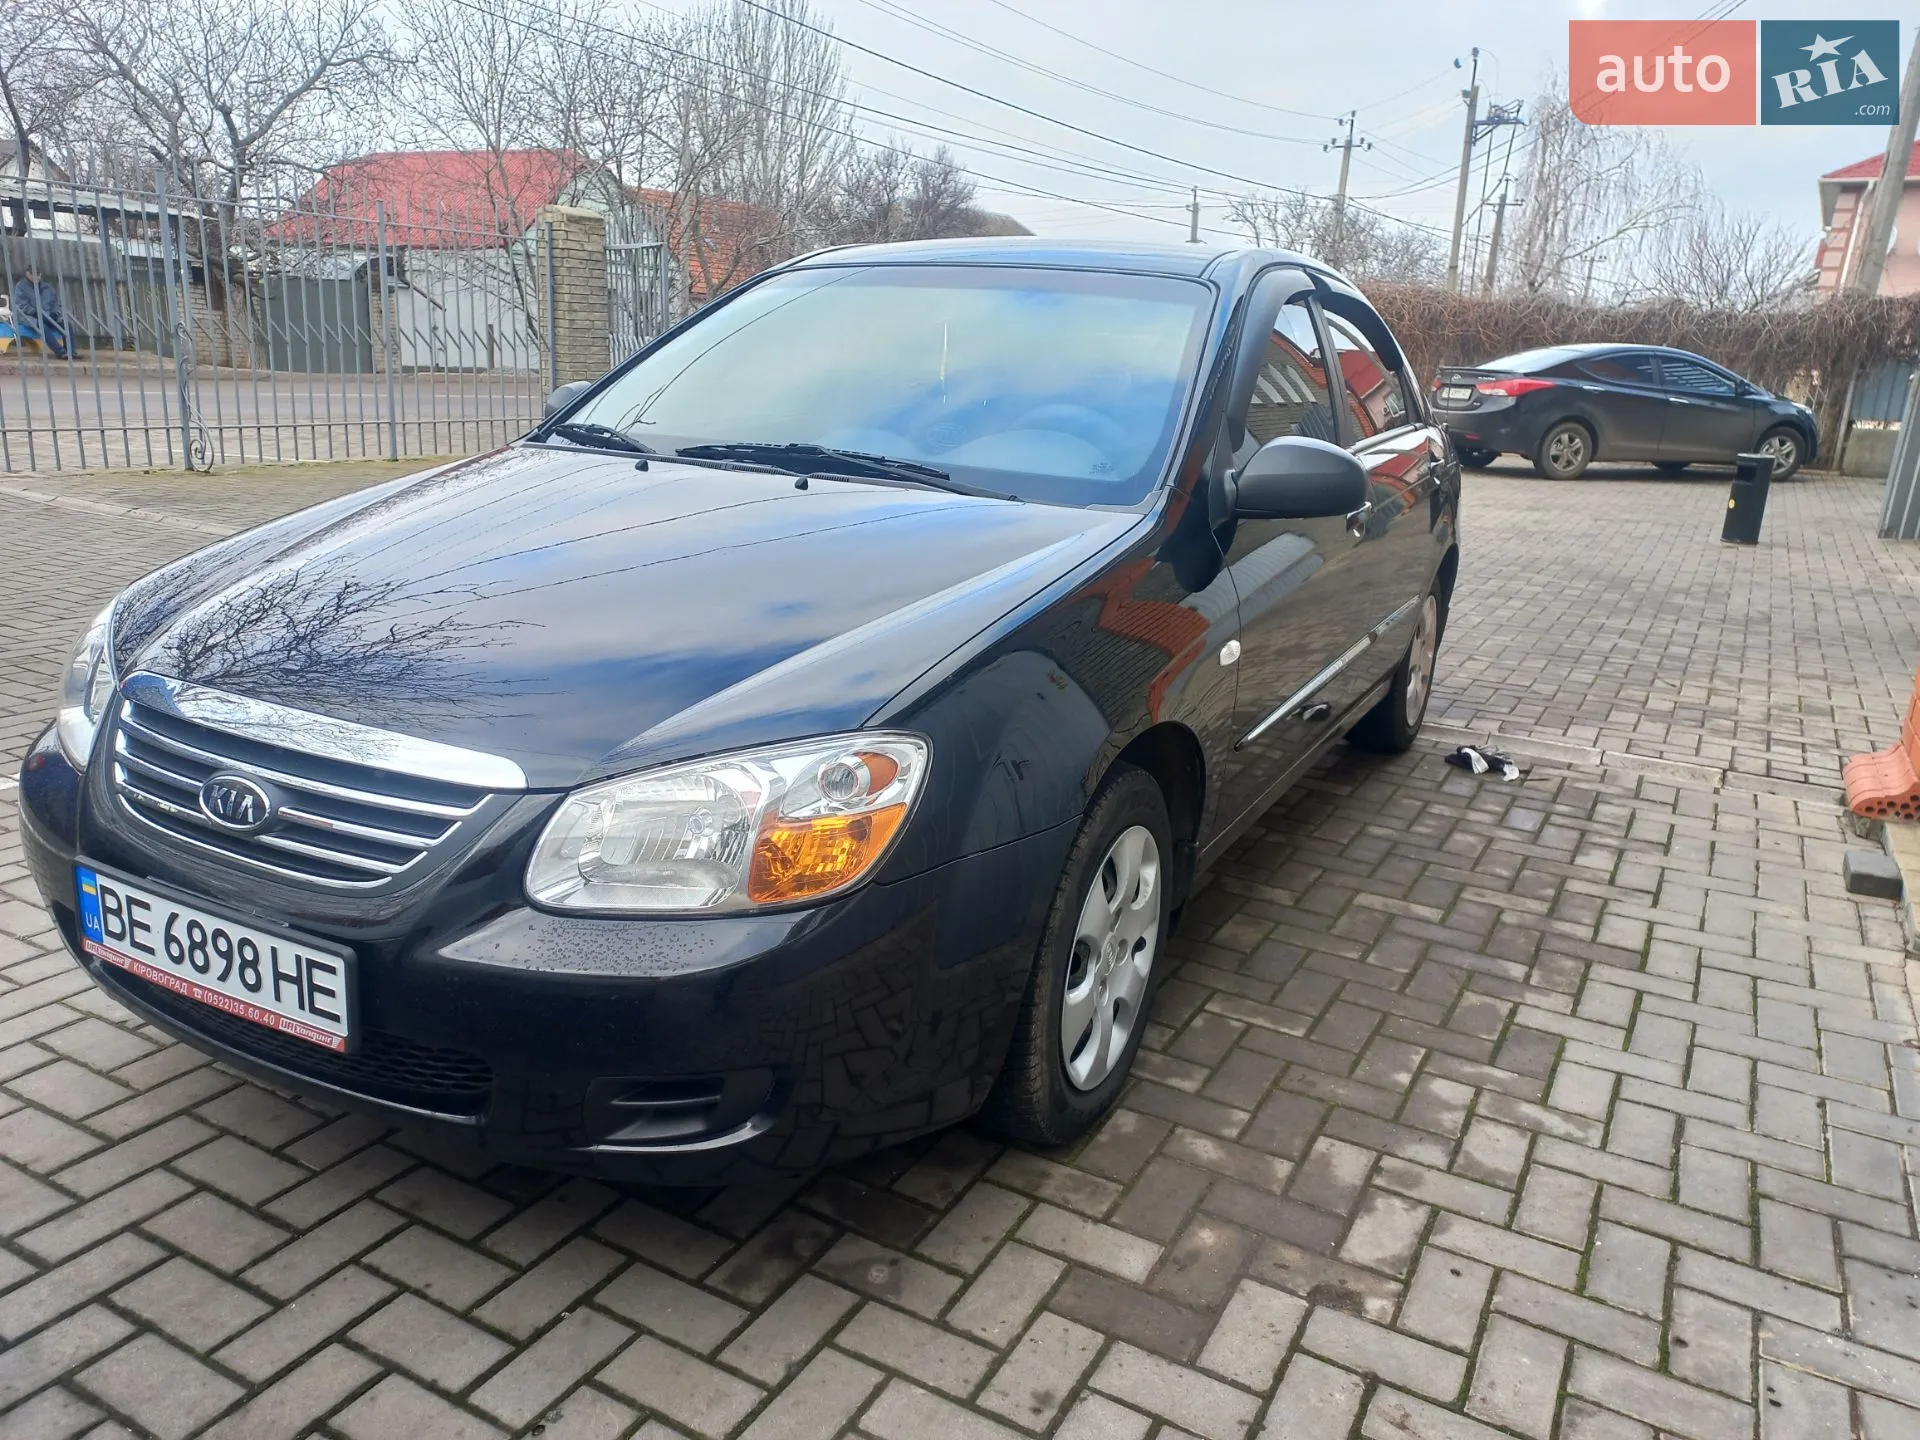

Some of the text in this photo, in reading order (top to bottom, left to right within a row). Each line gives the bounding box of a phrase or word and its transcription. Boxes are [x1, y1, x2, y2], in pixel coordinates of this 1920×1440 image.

[208, 784, 254, 823] KIA
[85, 912, 101, 932] UA
[99, 884, 341, 1023] BE 6898 HE
